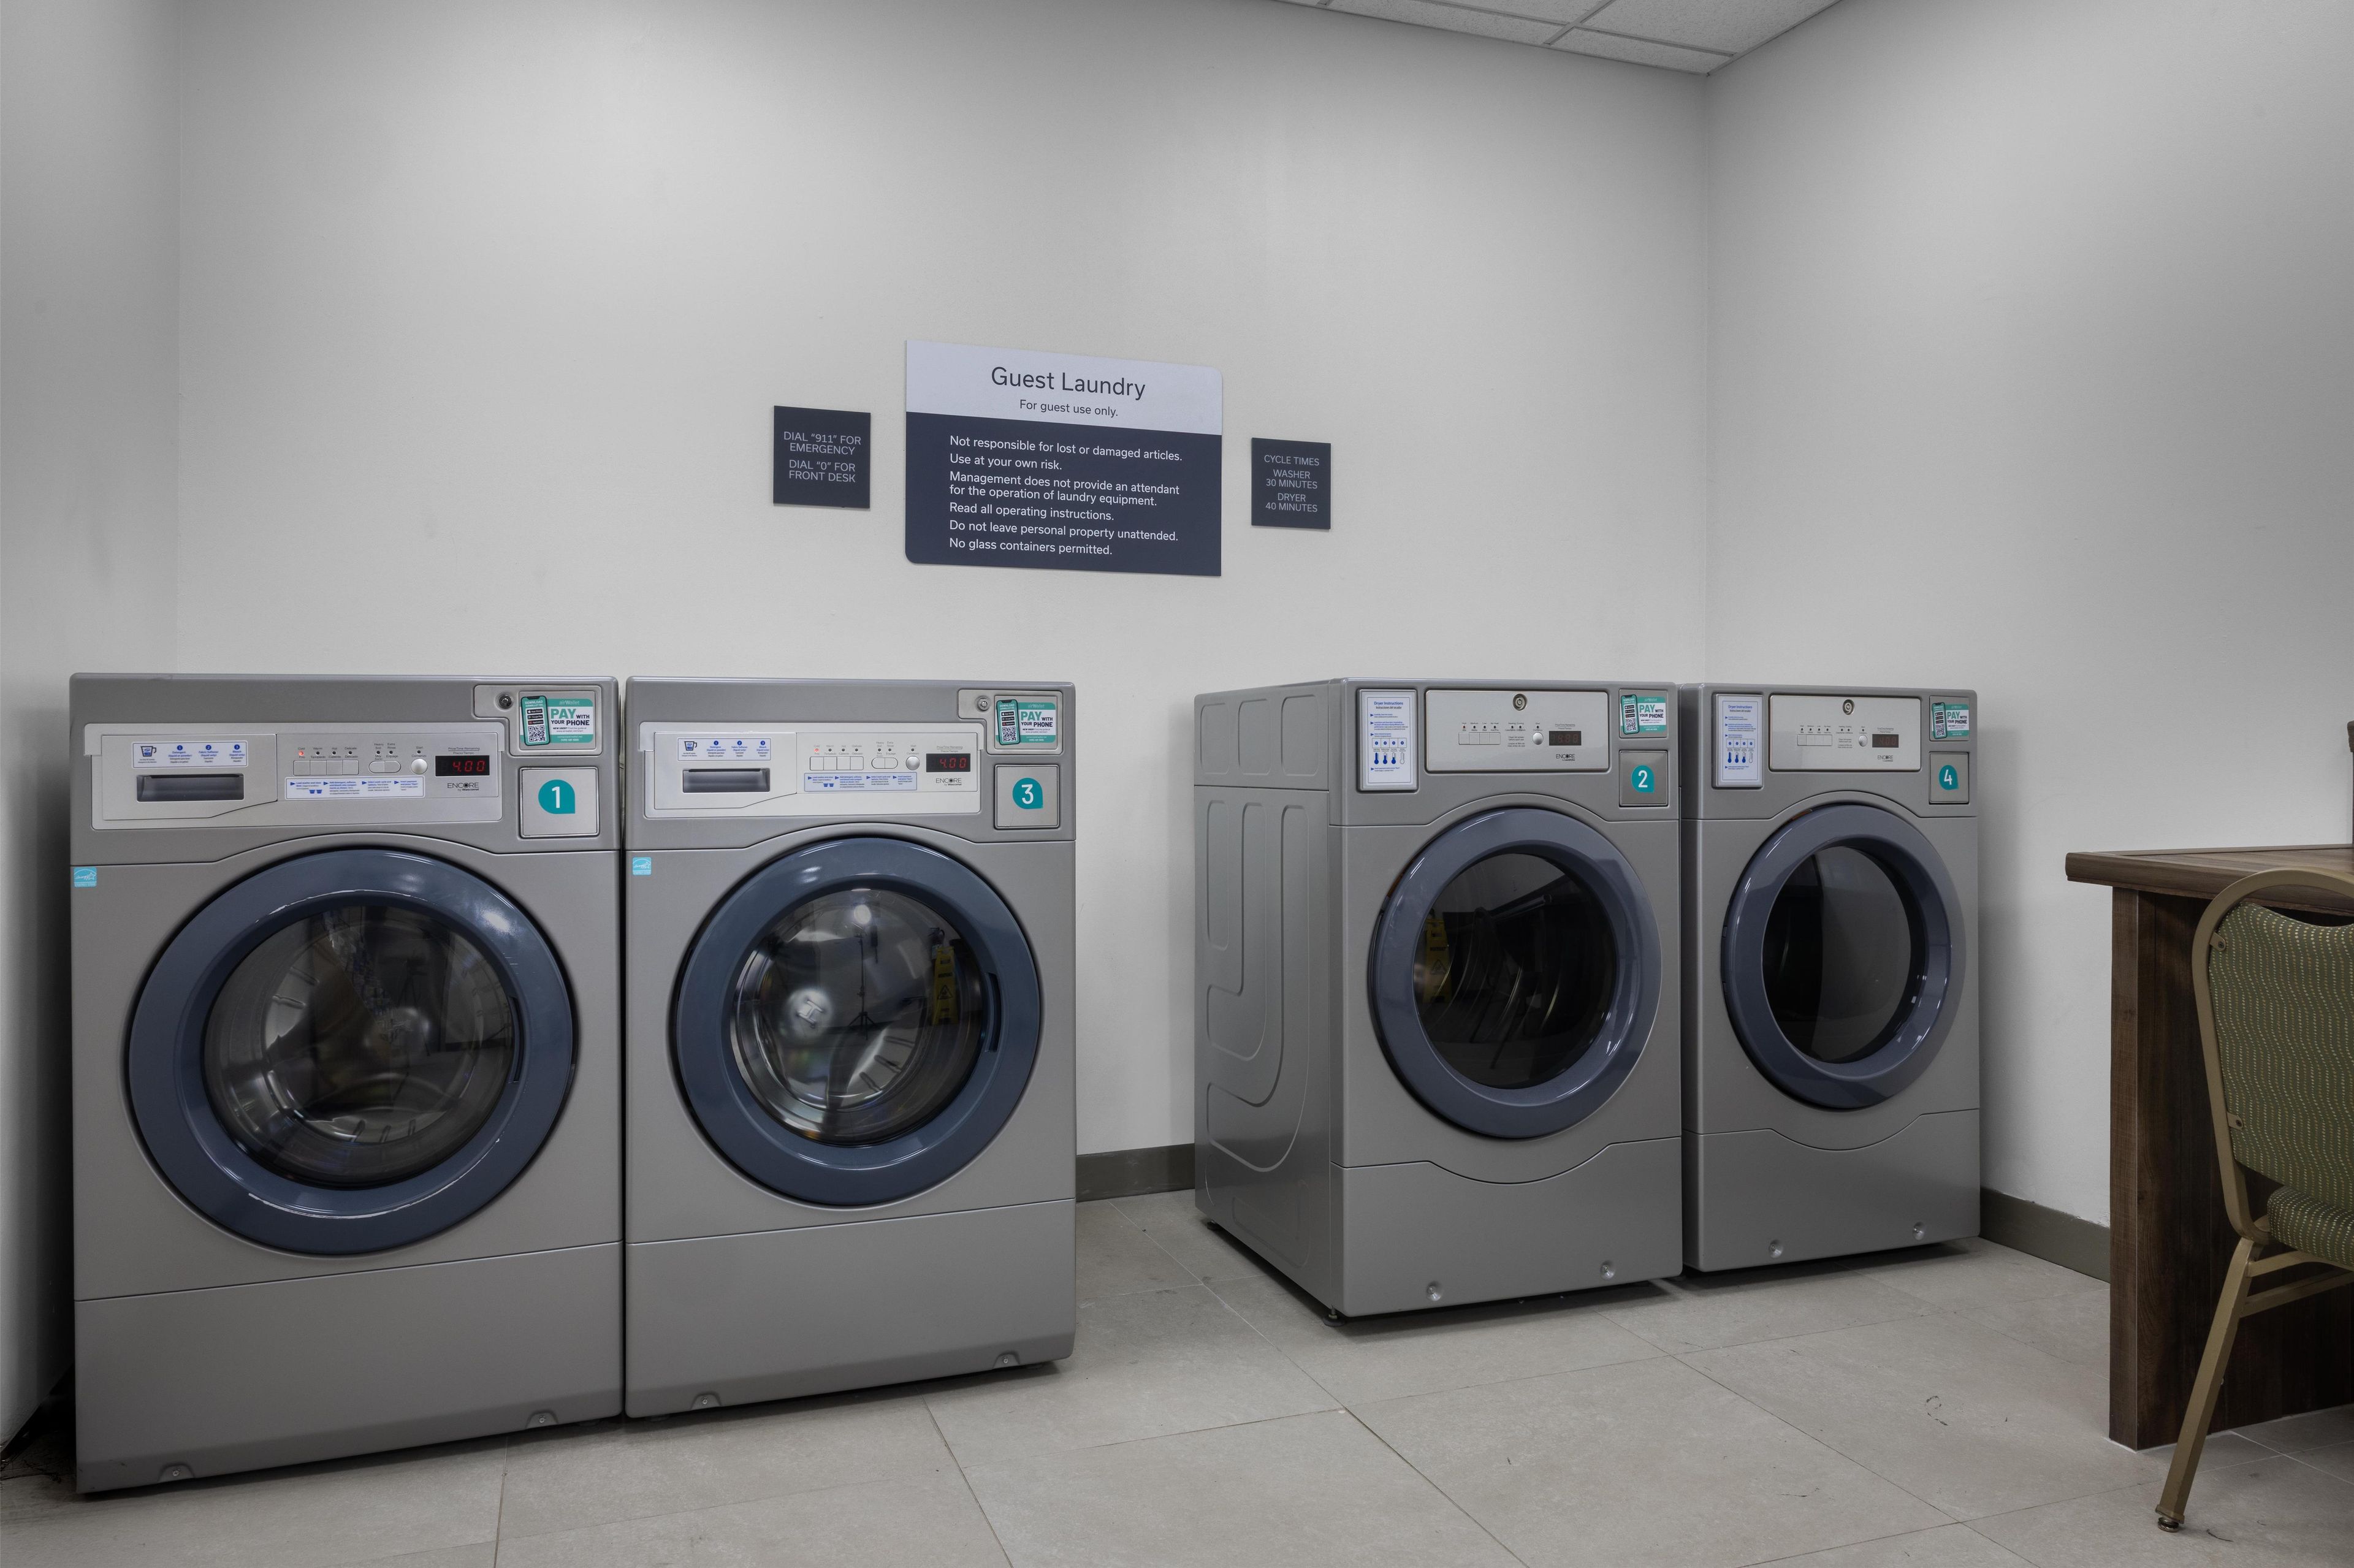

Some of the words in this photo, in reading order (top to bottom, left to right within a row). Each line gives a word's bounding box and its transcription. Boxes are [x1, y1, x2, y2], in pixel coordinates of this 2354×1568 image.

[992, 367, 1054, 389] Guest
[1062, 373, 1145, 400] Laundry
[1020, 400, 1037, 409] For
[1041, 404, 1070, 416] guest
[1095, 406, 1118, 417] only.
[784, 432, 808, 441] DIAL
[840, 436, 861, 445] FOR
[790, 443, 855, 455] EMERGENCY
[951, 435, 970, 446] Not
[974, 438, 1035, 452] responsible
[1038, 441, 1054, 451] for
[1057, 443, 1076, 454] lost
[1093, 446, 1140, 459] damaged
[1144, 450, 1182, 460] articles.
[790, 460, 813, 469] DIAL
[835, 463, 855, 471] FOR
[950, 453, 970, 464] Use
[975, 456, 985, 465] at
[988, 459, 1011, 469] your
[1042, 460, 1062, 470] risk.
[1265, 455, 1291, 464] CYCLE
[1293, 457, 1319, 466] TIMES
[790, 470, 825, 481] FRONT
[829, 473, 855, 482] DESK
[1273, 470, 1310, 479] WASHER
[950, 471, 1021, 484] Management
[1024, 476, 1050, 486] does
[1054, 479, 1070, 488] not
[1074, 480, 1112, 492] provide
[1131, 483, 1179, 494] attendant
[1279, 479, 1317, 489] MINUTES
[950, 484, 965, 495] for
[968, 485, 986, 496] the
[989, 489, 1040, 500] operation
[1043, 490, 1054, 500] of
[1057, 490, 1096, 504] laundry
[1100, 494, 1156, 507] equipment.
[1278, 493, 1306, 502] DRYER
[950, 502, 977, 513] Read
[981, 504, 992, 514] all
[996, 506, 1046, 519] operating
[1051, 508, 1114, 520] instructions.
[1279, 503, 1317, 512] MINUTES
[950, 520, 965, 530] Do
[969, 522, 986, 531] not
[991, 522, 1017, 533] leave
[1021, 526, 1065, 537] personal
[1070, 528, 1114, 539] property
[1118, 530, 1178, 541] unattended.
[950, 538, 965, 548] No
[969, 539, 996, 551] glass
[1000, 541, 1055, 552] containers
[1059, 544, 1112, 554] permitted.
[550, 709, 576, 718] PAY
[1021, 712, 1042, 721] PAY
[452, 761, 486, 772] 4.00
[1639, 771, 1647, 787] 2
[1945, 770, 1952, 785] 4
[552, 786, 560, 808] 1
[1022, 785, 1033, 804] 3
